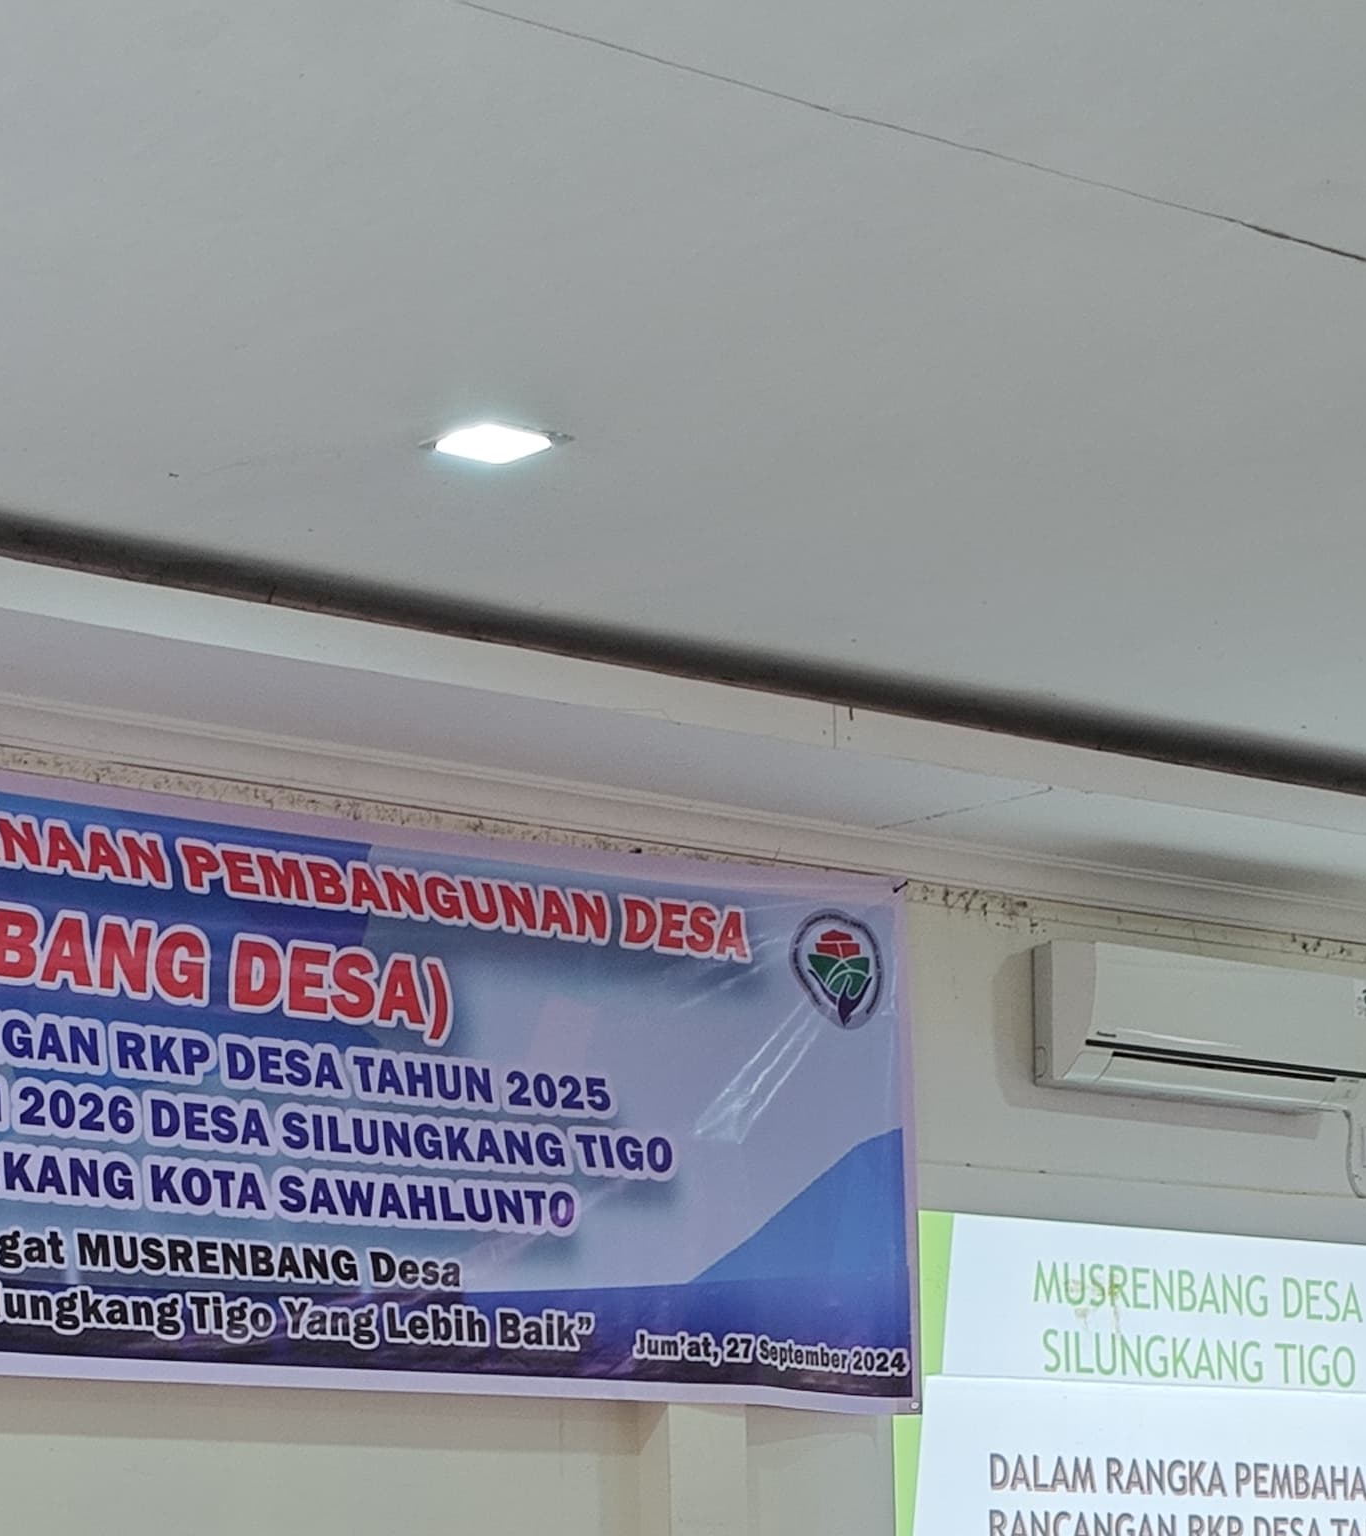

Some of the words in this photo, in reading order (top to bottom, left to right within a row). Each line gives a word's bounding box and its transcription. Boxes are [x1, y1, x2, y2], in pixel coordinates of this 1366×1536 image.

[181, 844, 607, 942] PEMBANGUNAN
[622, 901, 749, 960] DESA
[231, 934, 452, 1041] DESA)
[117, 1028, 210, 1076] RKP
[226, 1041, 342, 1092] DESA
[354, 1056, 494, 1104] TAHUN
[506, 1069, 612, 1112] 2025
[19, 1086, 135, 1134] 2026
[152, 1101, 269, 1150] DESA
[281, 1114, 565, 1169] SILUNGKANG
[575, 1134, 673, 1174] TIGO
[152, 1165, 266, 1212] KOTA
[277, 1177, 575, 1230] SAWAHLUNTO
[77, 1230, 359, 1284] MUSRENBANG
[370, 1250, 461, 1289] Desa
[1033, 1260, 1269, 1319] MUSRENBANG
[1282, 1278, 1363, 1323] DESA
[191, 1298, 272, 1342] Tigo
[284, 1306, 377, 1349] Yang
[387, 1306, 489, 1344] Lebih
[724, 1337, 753, 1362] 27
[758, 1342, 850, 1375] September
[852, 1349, 907, 1375] 2024
[1042, 1330, 1264, 1384] SILUNGKANG
[1274, 1344, 1356, 1388] TIGO
[989, 1453, 1096, 1493] DALAM
[1106, 1457, 1227, 1498] RANGKA
